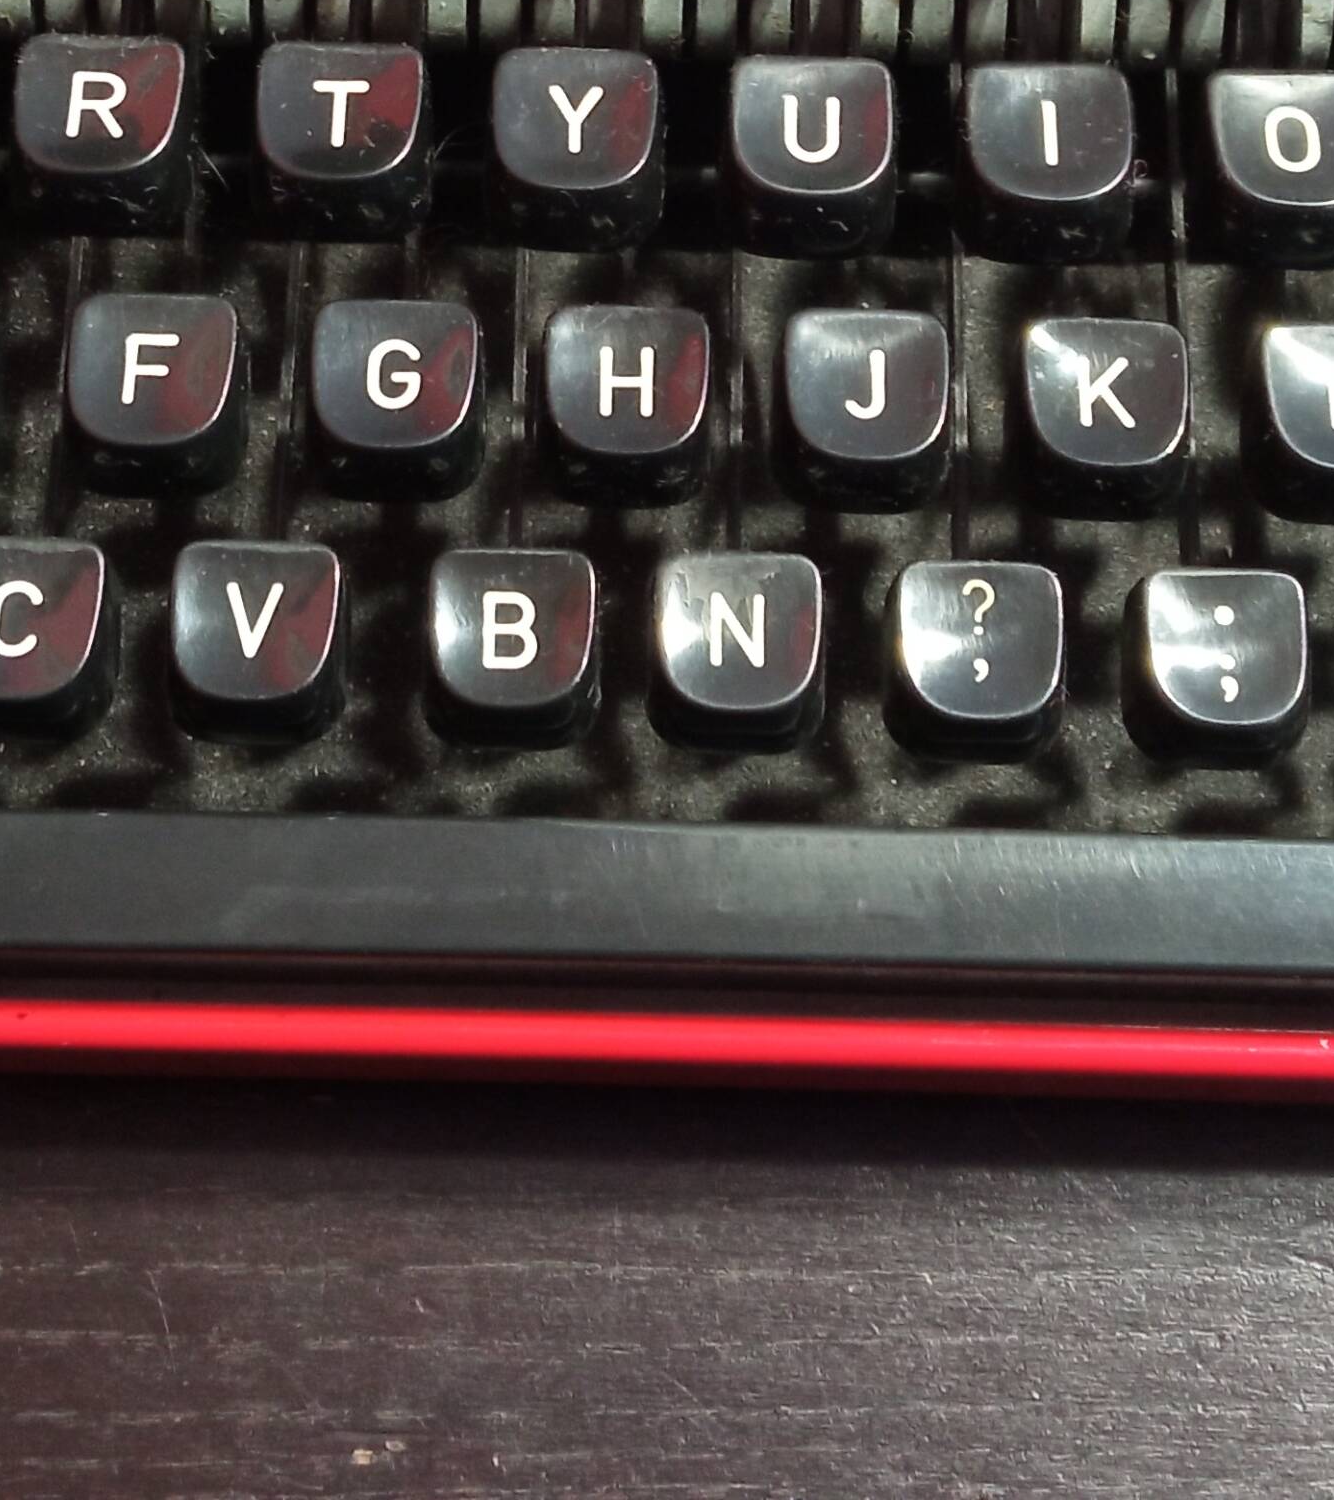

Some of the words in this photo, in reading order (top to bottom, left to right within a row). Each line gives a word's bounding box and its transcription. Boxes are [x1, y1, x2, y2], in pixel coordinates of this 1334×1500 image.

[65, 70, 126, 139] R
[312, 80, 370, 149] T
[547, 84, 604, 154] Y
[782, 93, 841, 164] U
[1040, 99, 1059, 167] I
[1264, 105, 1322, 173] O
[121, 332, 180, 405] F
[365, 338, 422, 411] G
[598, 345, 654, 418] H
[844, 348, 887, 420] J
[1076, 356, 1137, 429] K
[226, 581, 284, 658] V
[481, 590, 539, 669] B
[708, 590, 767, 668] N
[961, 578, 997, 636] ?
